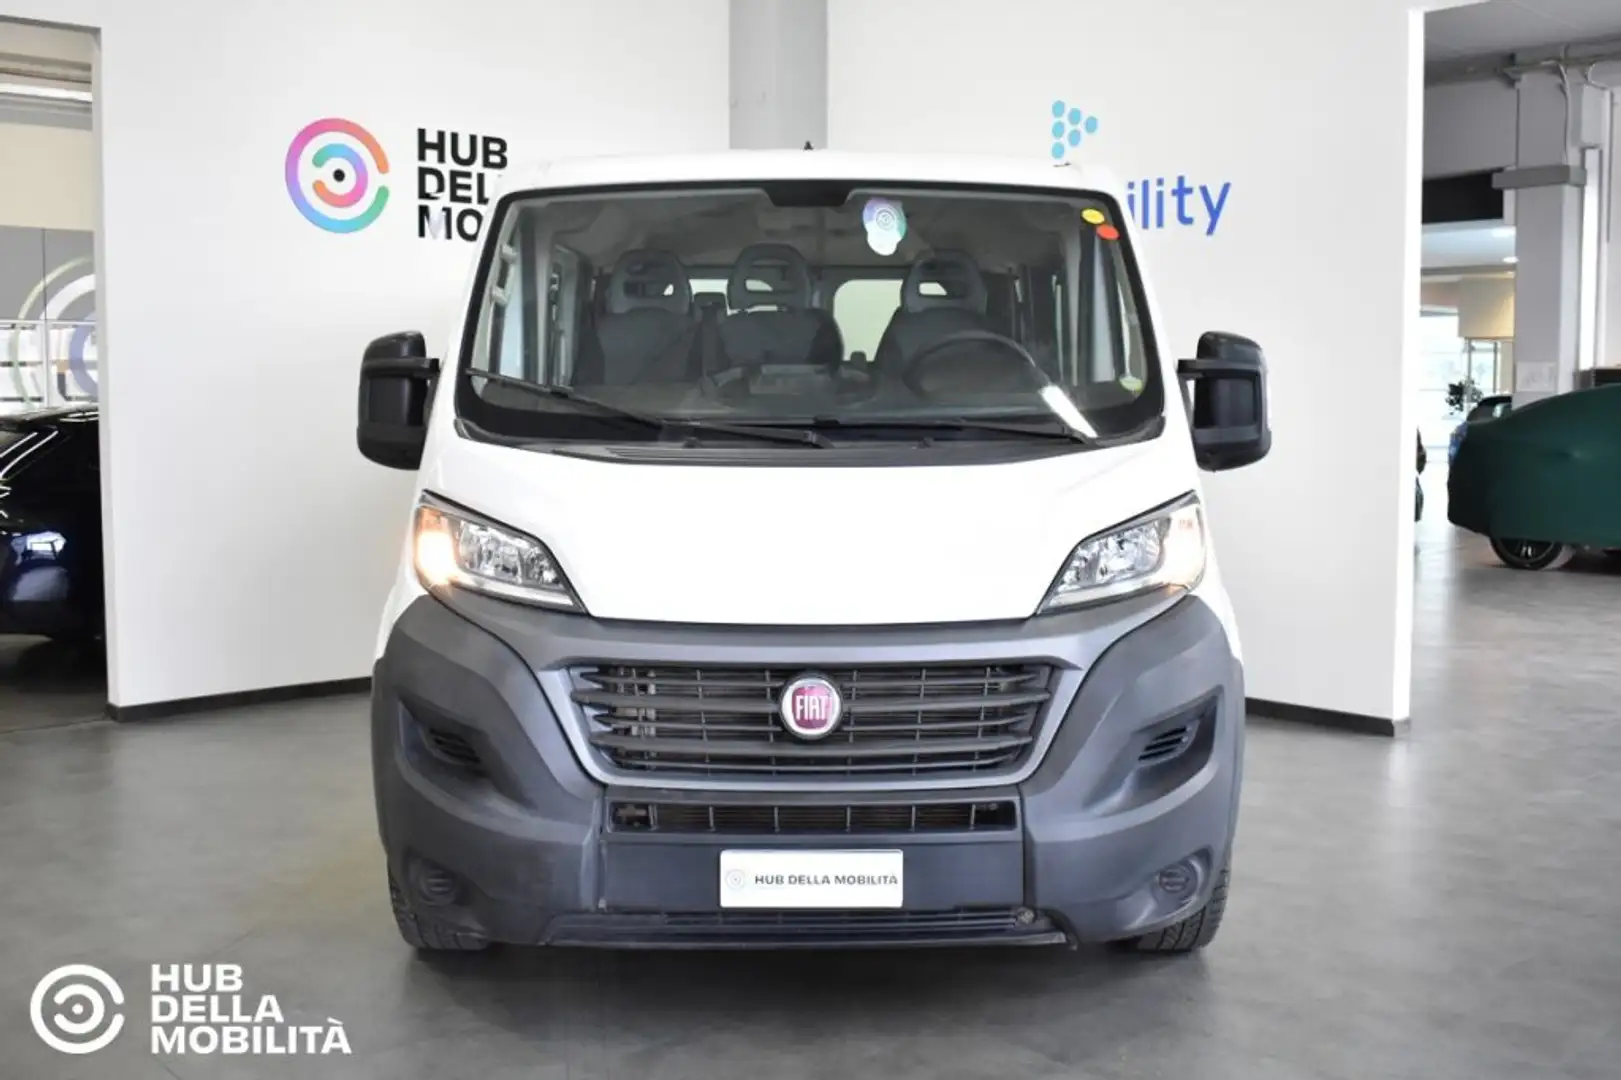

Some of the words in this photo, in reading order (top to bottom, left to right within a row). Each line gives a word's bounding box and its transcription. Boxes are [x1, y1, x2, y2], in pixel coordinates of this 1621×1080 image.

[417, 128, 508, 170] HUB
[417, 166, 489, 205] DEL
[1127, 175, 1231, 237] ility
[796, 695, 829, 720] FIAT
[755, 875, 784, 885] HUB
[788, 875, 831, 885] DELLA
